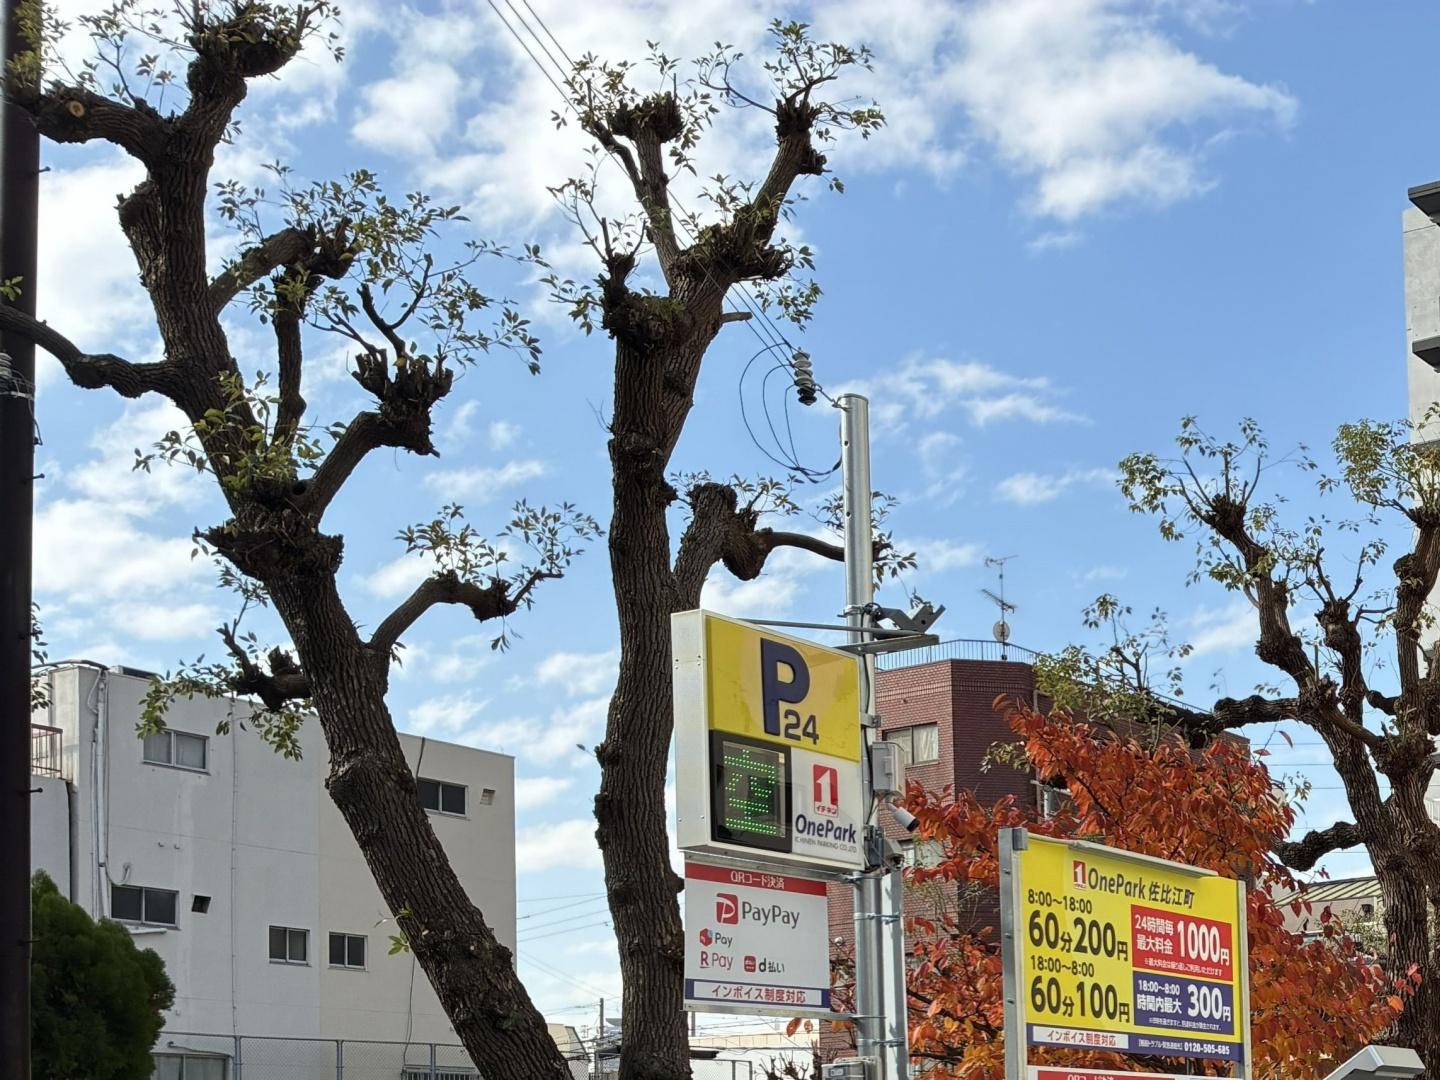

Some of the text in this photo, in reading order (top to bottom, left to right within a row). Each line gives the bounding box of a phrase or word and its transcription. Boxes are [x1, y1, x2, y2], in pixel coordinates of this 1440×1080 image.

[760, 638, 811, 737] P
[784, 709, 820, 746] 24
[724, 749, 778, 835] 空
[795, 814, 857, 844] OnePark
[730, 870, 785, 890] QRコード決済
[1087, 868, 1195, 910] OnePark 佐比江町
[741, 900, 801, 930] PayPay
[1134, 914, 1175, 937] 24時間毎
[714, 932, 733, 949] Pay
[1136, 934, 1174, 956] 最大料金
[1177, 919, 1231, 967] 1000円
[712, 952, 734, 971] Pay
[758, 957, 786, 974] d払い
[711, 984, 807, 1005] インボイス制度対応
[1136, 993, 1182, 1015] 時間内最大
[1187, 983, 1232, 1022] 300円
[1047, 1029, 1117, 1047] インボイス制度対応
[1184, 1041, 1230, 1056] 0120-505-685
